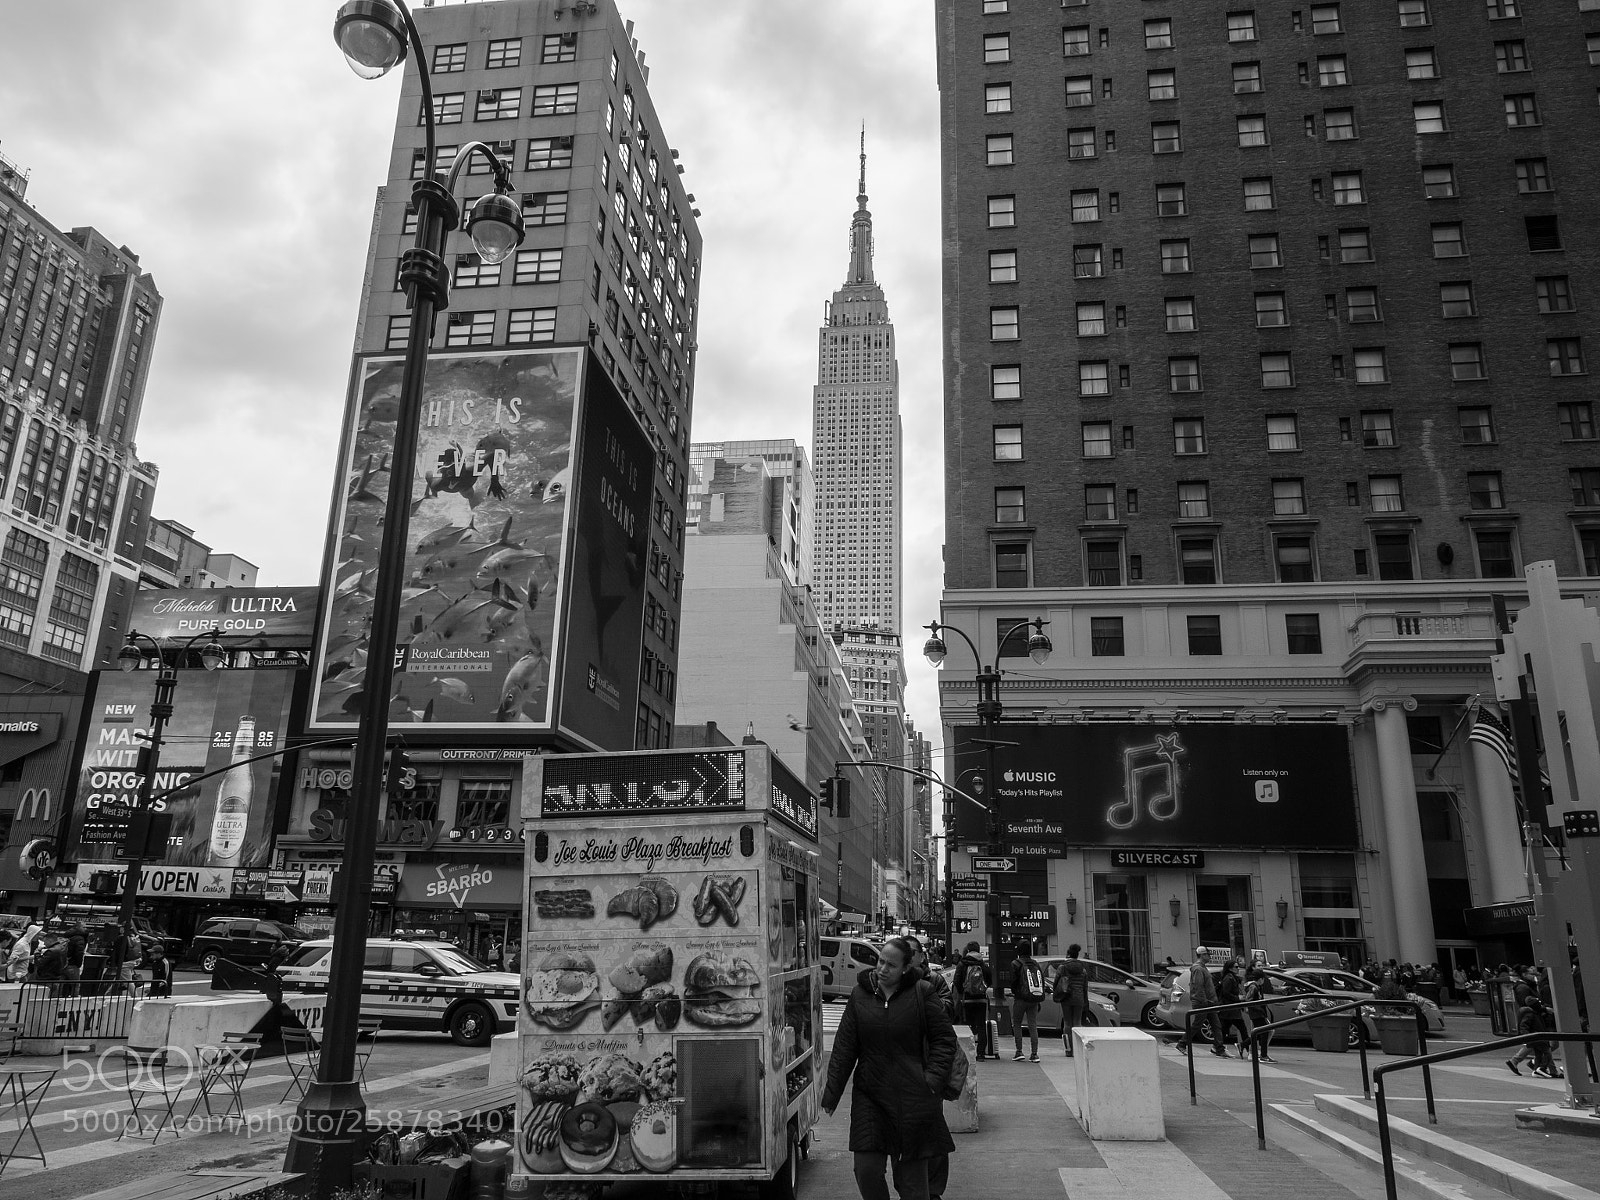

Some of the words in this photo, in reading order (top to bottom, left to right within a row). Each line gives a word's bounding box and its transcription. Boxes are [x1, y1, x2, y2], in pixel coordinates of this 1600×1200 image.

[427, 399, 475, 426] HIS
[495, 397, 522, 424] IS
[413, 449, 507, 478] NEVER
[606, 427, 626, 475] THIS
[629, 461, 638, 492] IS
[600, 476, 635, 538] OCEANS
[153, 598, 217, 614] Michelob
[231, 597, 297, 613] ULTRA
[178, 619, 219, 631] PURE
[223, 618, 266, 630] GOLD
[105, 704, 136, 715] NEW
[213, 731, 232, 742] 2.5
[258, 731, 274, 742] 85
[97, 749, 138, 767] WIT
[300, 767, 417, 790] HOOS
[1015, 772, 1056, 782] MUSIC
[1242, 768, 1264, 776] Listen
[1264, 769, 1279, 778] only
[1039, 789, 1063, 798] Playlist
[102, 801, 116, 816] West
[86, 830, 112, 839] Fashion
[112, 831, 127, 839] Ave
[308, 808, 446, 850] Suway
[487, 829, 494, 840] 2
[504, 830, 512, 841] 3
[1007, 823, 1043, 833] Seventh
[1045, 824, 1062, 834] Ave
[554, 839, 577, 866] Joe
[580, 839, 618, 860] Louis
[621, 836, 664, 870] Plaza
[666, 835, 733, 865] Breakfast
[1010, 845, 1024, 854] Joe
[1026, 845, 1047, 855] Louis
[152, 871, 200, 892] OPEN
[426, 869, 494, 897] SBARRO
[541, 1039, 576, 1050] Donuts
[577, 1041, 586, 1050] &
[587, 1038, 629, 1052] Muffins
